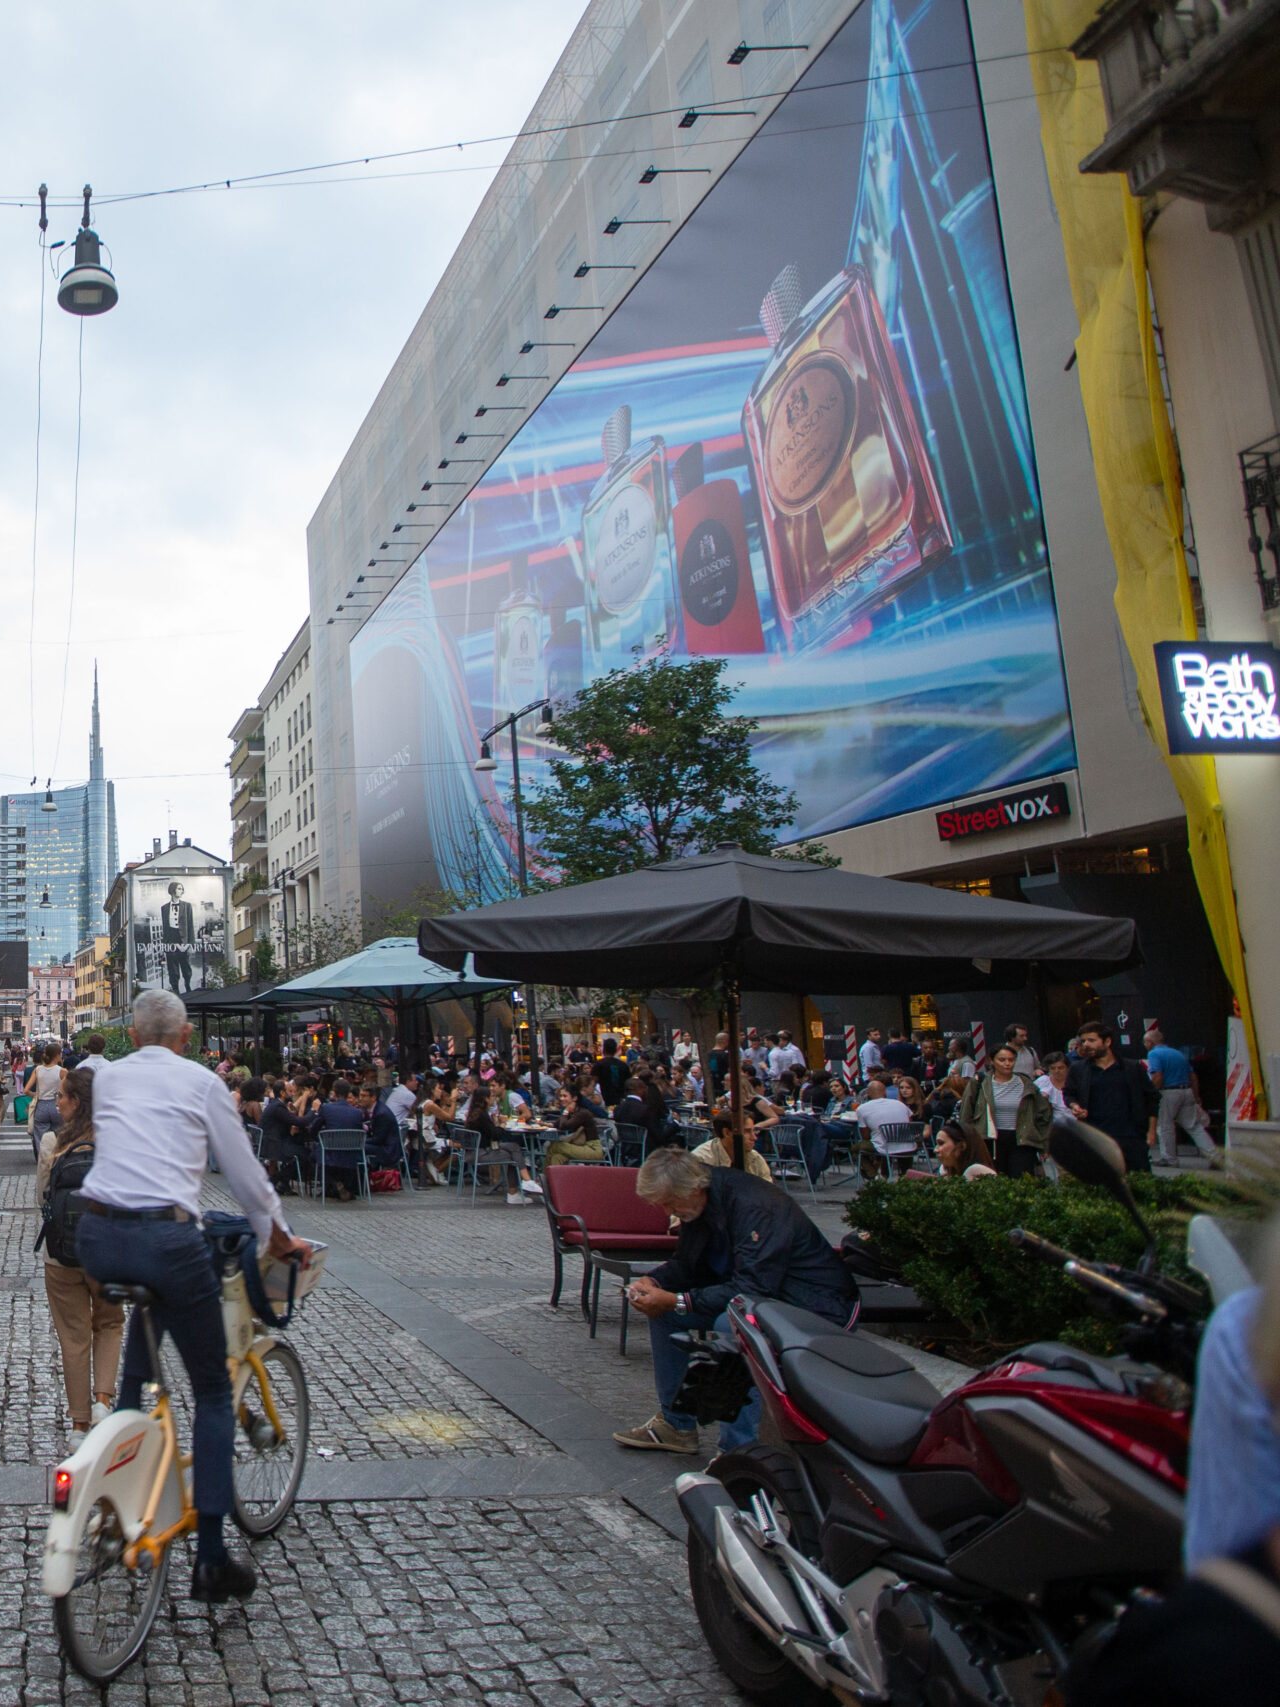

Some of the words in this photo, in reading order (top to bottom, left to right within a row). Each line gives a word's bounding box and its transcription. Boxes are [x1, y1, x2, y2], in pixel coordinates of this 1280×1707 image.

[604, 526, 648, 568] ATKINSONS
[688, 554, 732, 587] ATKINSONS
[1172, 651, 1275, 693] Bath
[1181, 708, 1280, 740] Works
[137, 942, 176, 953] EMPORIO
[188, 942, 224, 953] ARMANI
